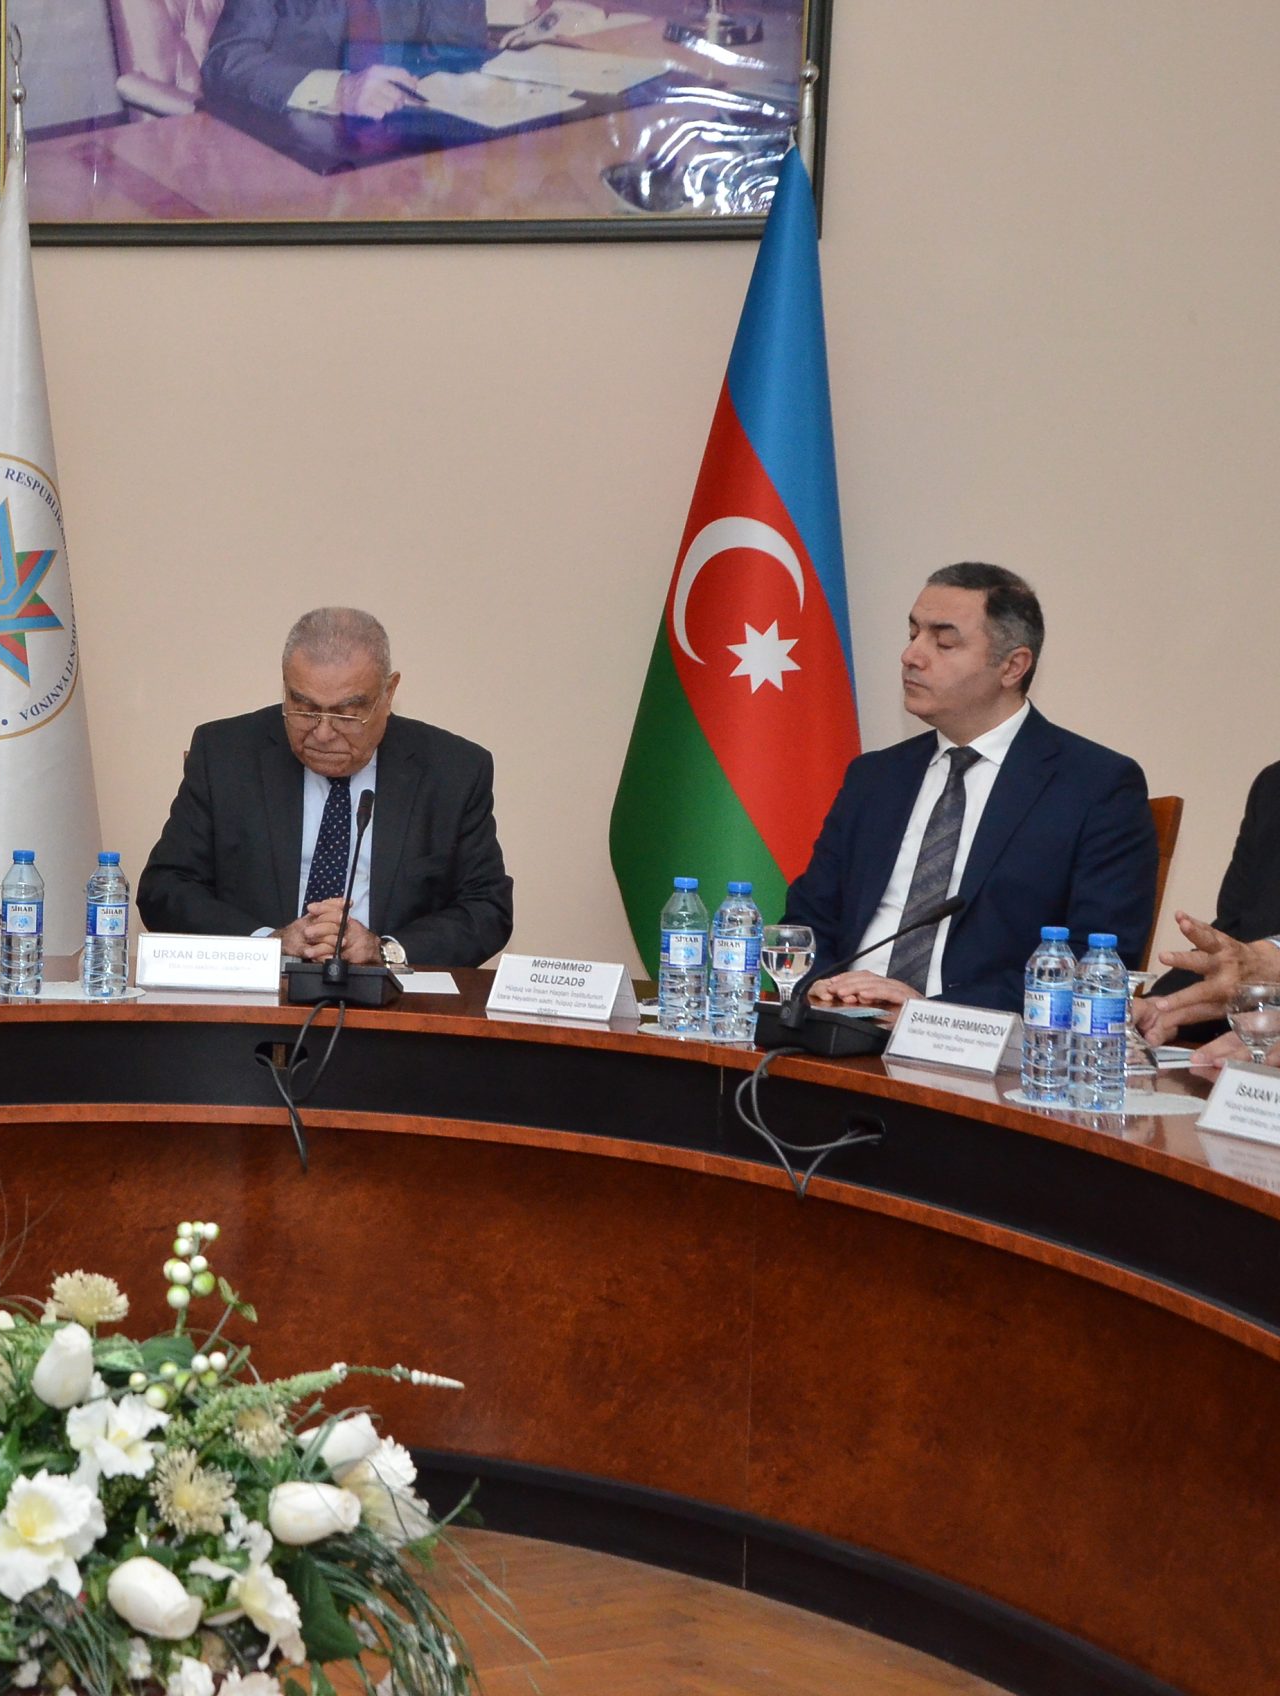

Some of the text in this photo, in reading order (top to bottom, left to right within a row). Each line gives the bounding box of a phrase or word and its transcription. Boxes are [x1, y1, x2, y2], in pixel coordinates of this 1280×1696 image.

[153, 948, 270, 961] URXAN ƏLƏKBƏROV
[531, 959, 593, 973] MƏHƏMMƏD
[529, 973, 586, 988] QULUZADƏ
[910, 1011, 1008, 1037] ŞAHMAR MƏMMƏDOV
